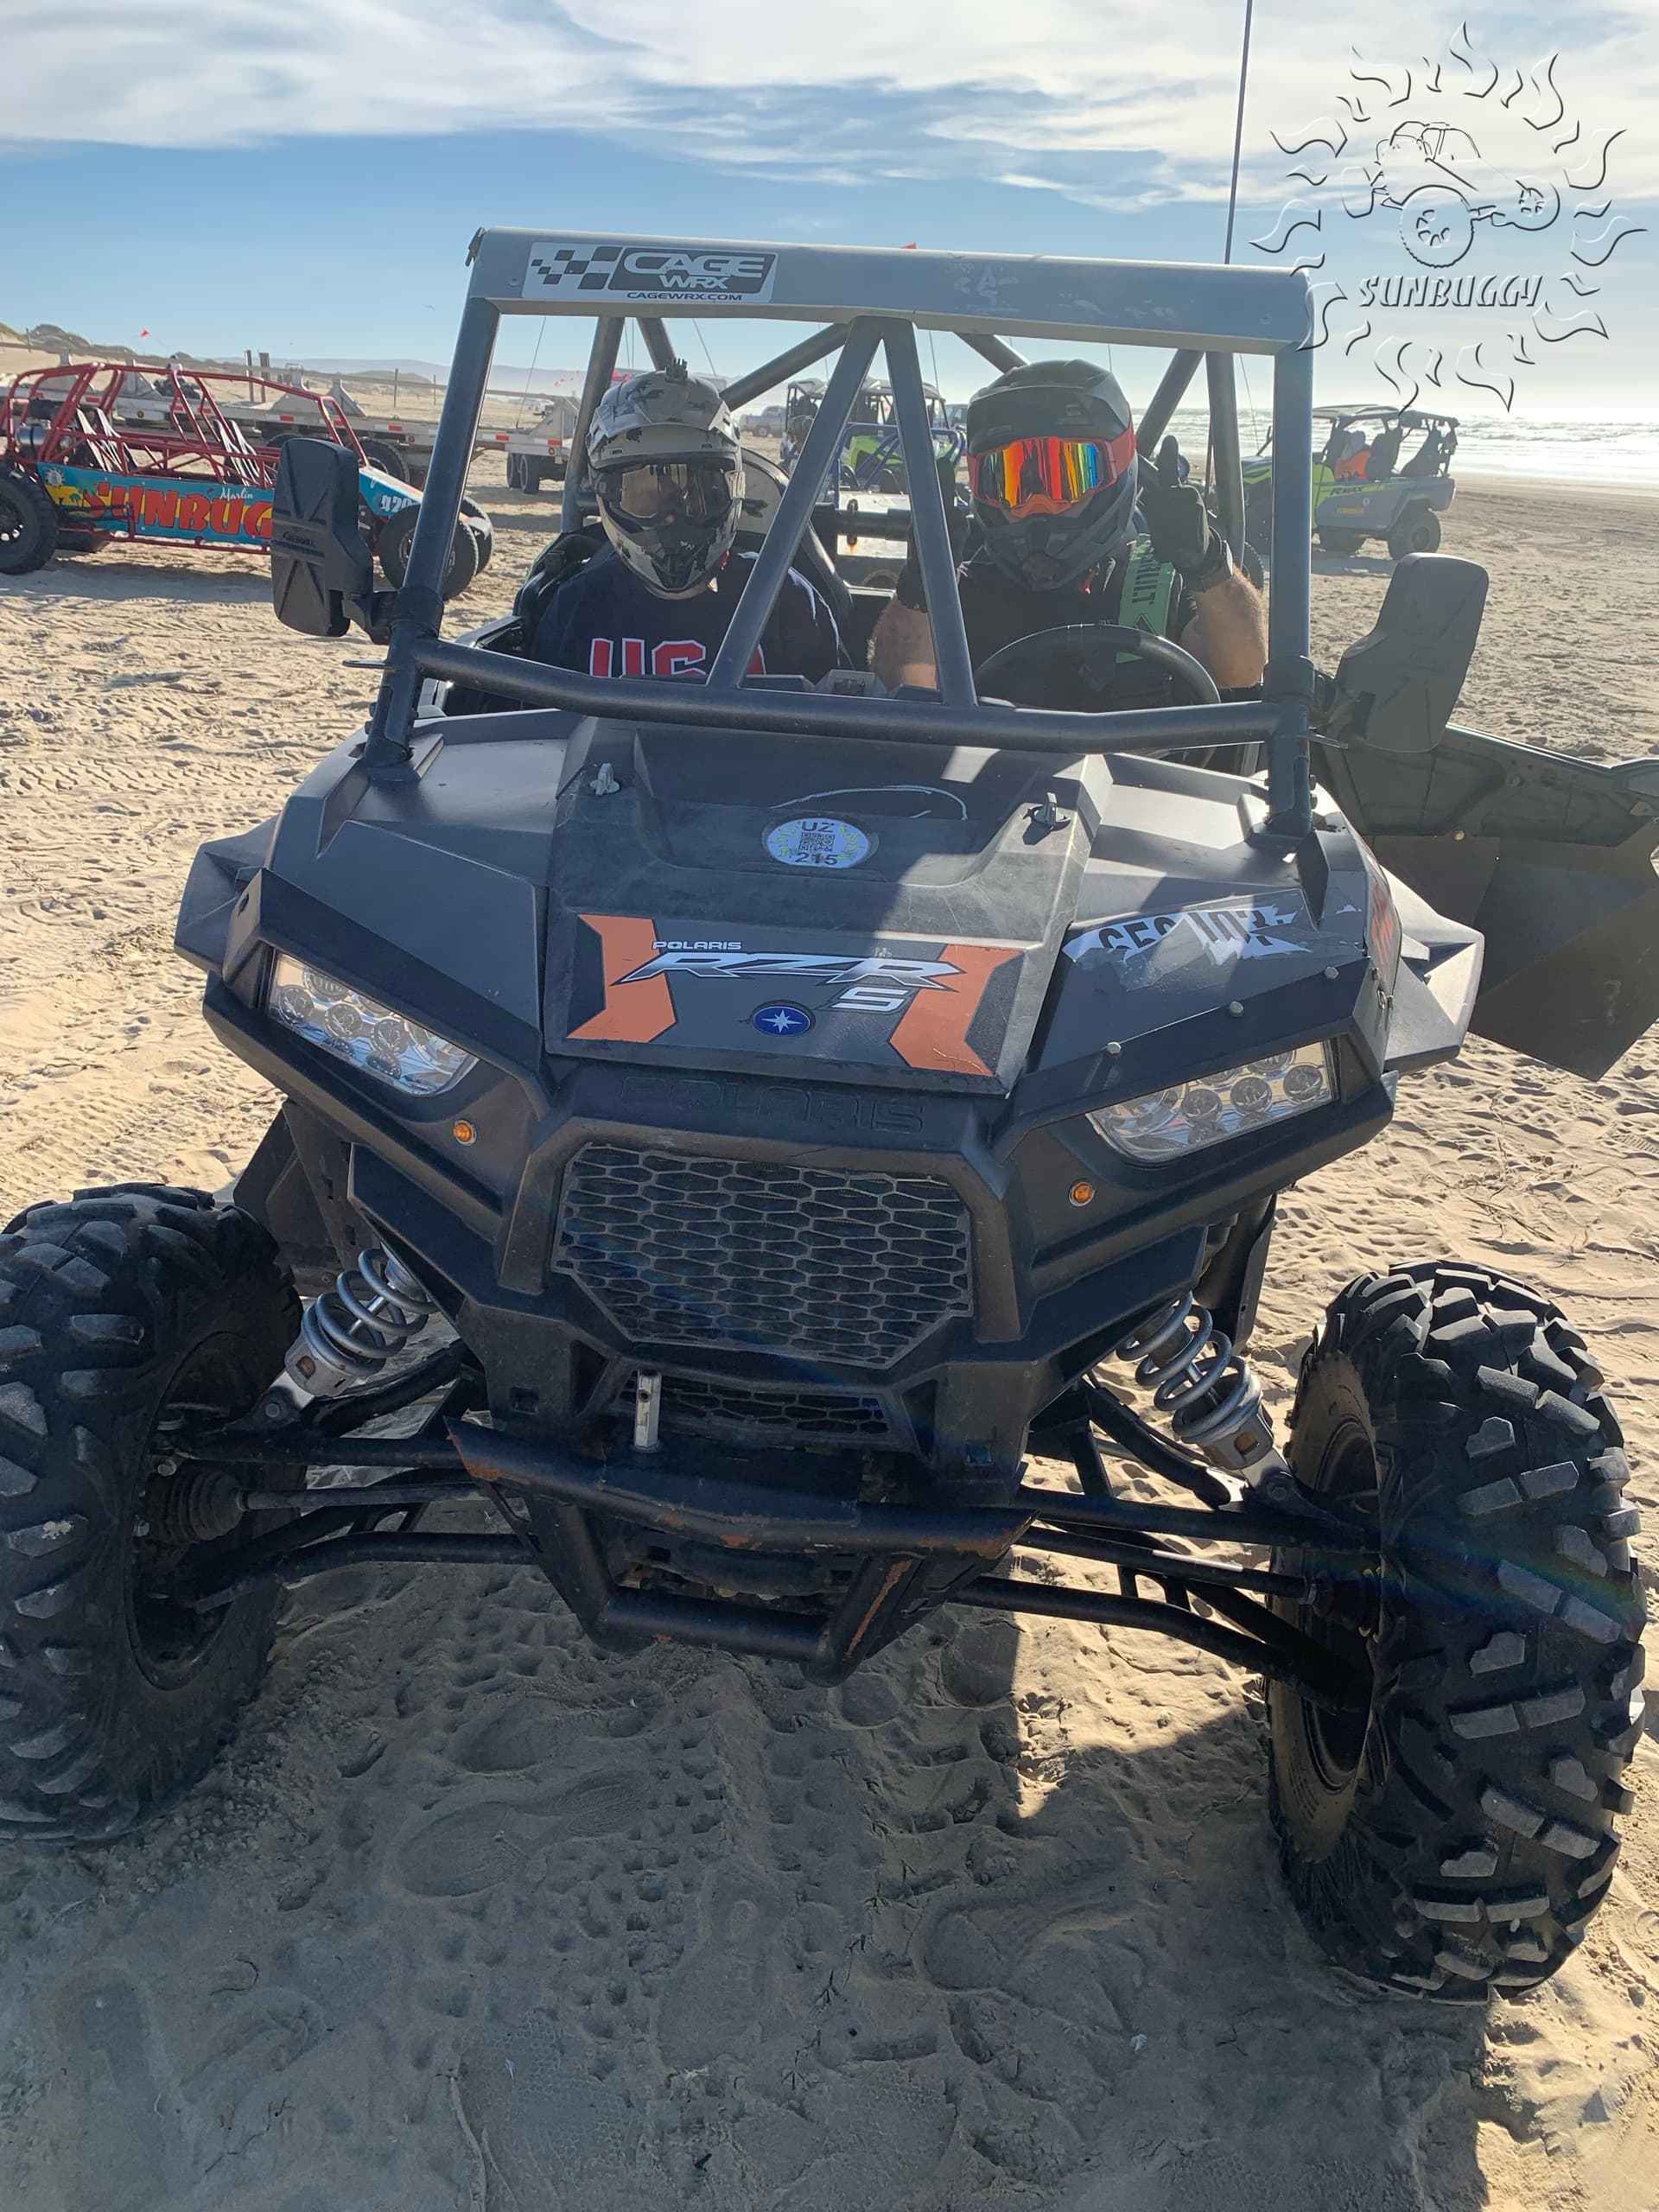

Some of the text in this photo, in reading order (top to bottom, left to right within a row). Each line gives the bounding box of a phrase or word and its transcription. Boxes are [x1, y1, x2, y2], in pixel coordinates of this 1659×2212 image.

[624, 252, 765, 277] CAGE
[659, 274, 730, 289] WRX
[627, 292, 742, 301] CAGEWRX.COM
[219, 486, 254, 500] Marlin
[802, 822, 835, 832] UZ
[795, 852, 838, 864] 215
[652, 941, 742, 950] POLARIS
[610, 952, 965, 991] RZR
[831, 987, 911, 1012] S
[618, 1077, 924, 1135] POLARIS
